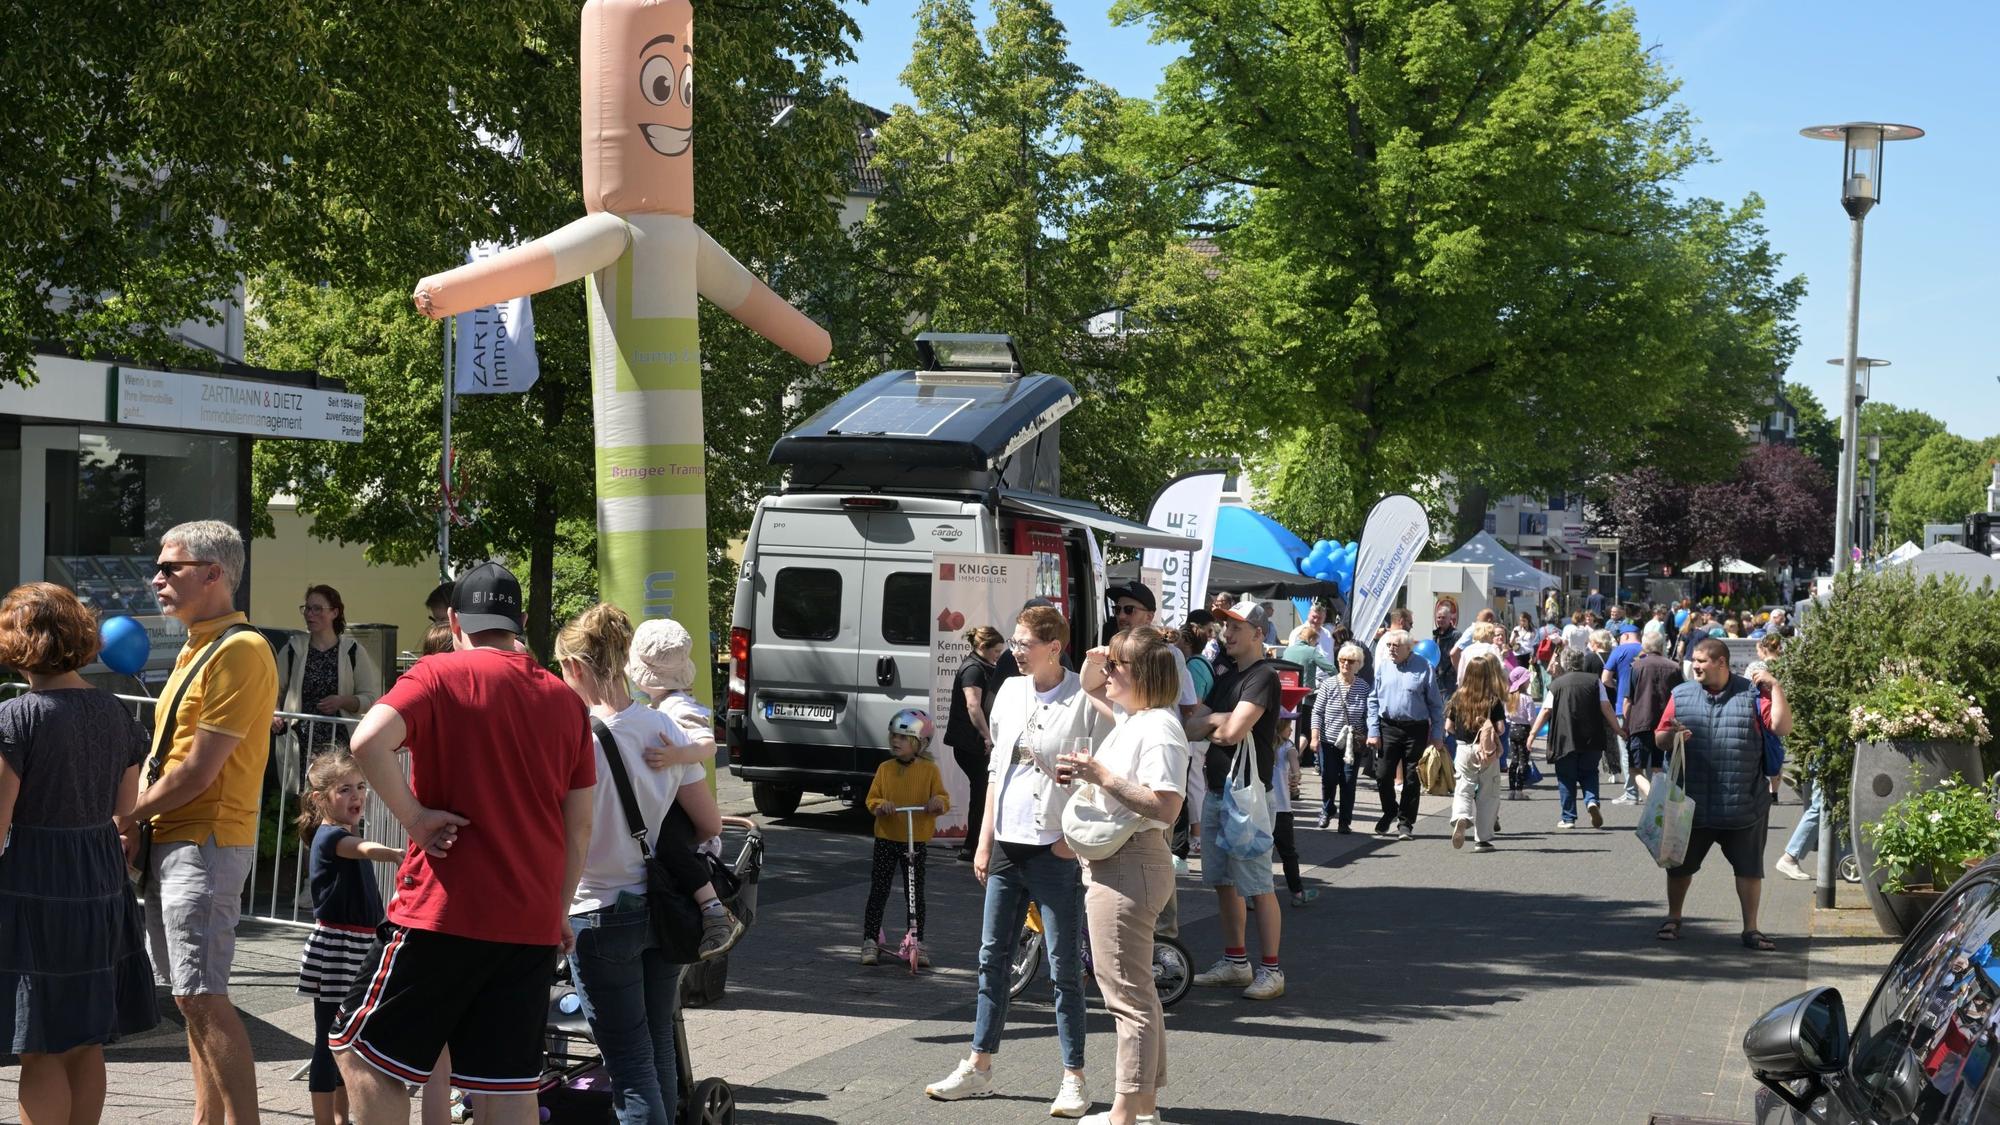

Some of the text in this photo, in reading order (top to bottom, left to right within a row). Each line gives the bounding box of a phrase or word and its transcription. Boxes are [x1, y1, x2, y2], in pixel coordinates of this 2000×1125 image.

[493, 301, 509, 387] Immobil
[632, 350, 677, 367] Jump
[201, 383, 302, 411] ZARTMANN & DIETZ
[327, 396, 339, 407] Seit
[354, 400, 363, 410] ein
[201, 407, 302, 432] Immobilienmanagement
[325, 411, 363, 425] zuverlässiger
[341, 425, 363, 437] Partner
[612, 464, 705, 480] Bungee Tramp
[773, 521, 962, 537] pro carado
[1372, 543, 1406, 598] Bensberger
[1400, 521, 1421, 546] Bank
[958, 563, 1008, 576] KNIGGE
[958, 576, 1008, 584] IMMOBILIEN
[937, 653, 957, 664] den
[774, 703, 786, 716] GL
[807, 705, 832, 718] 7000
